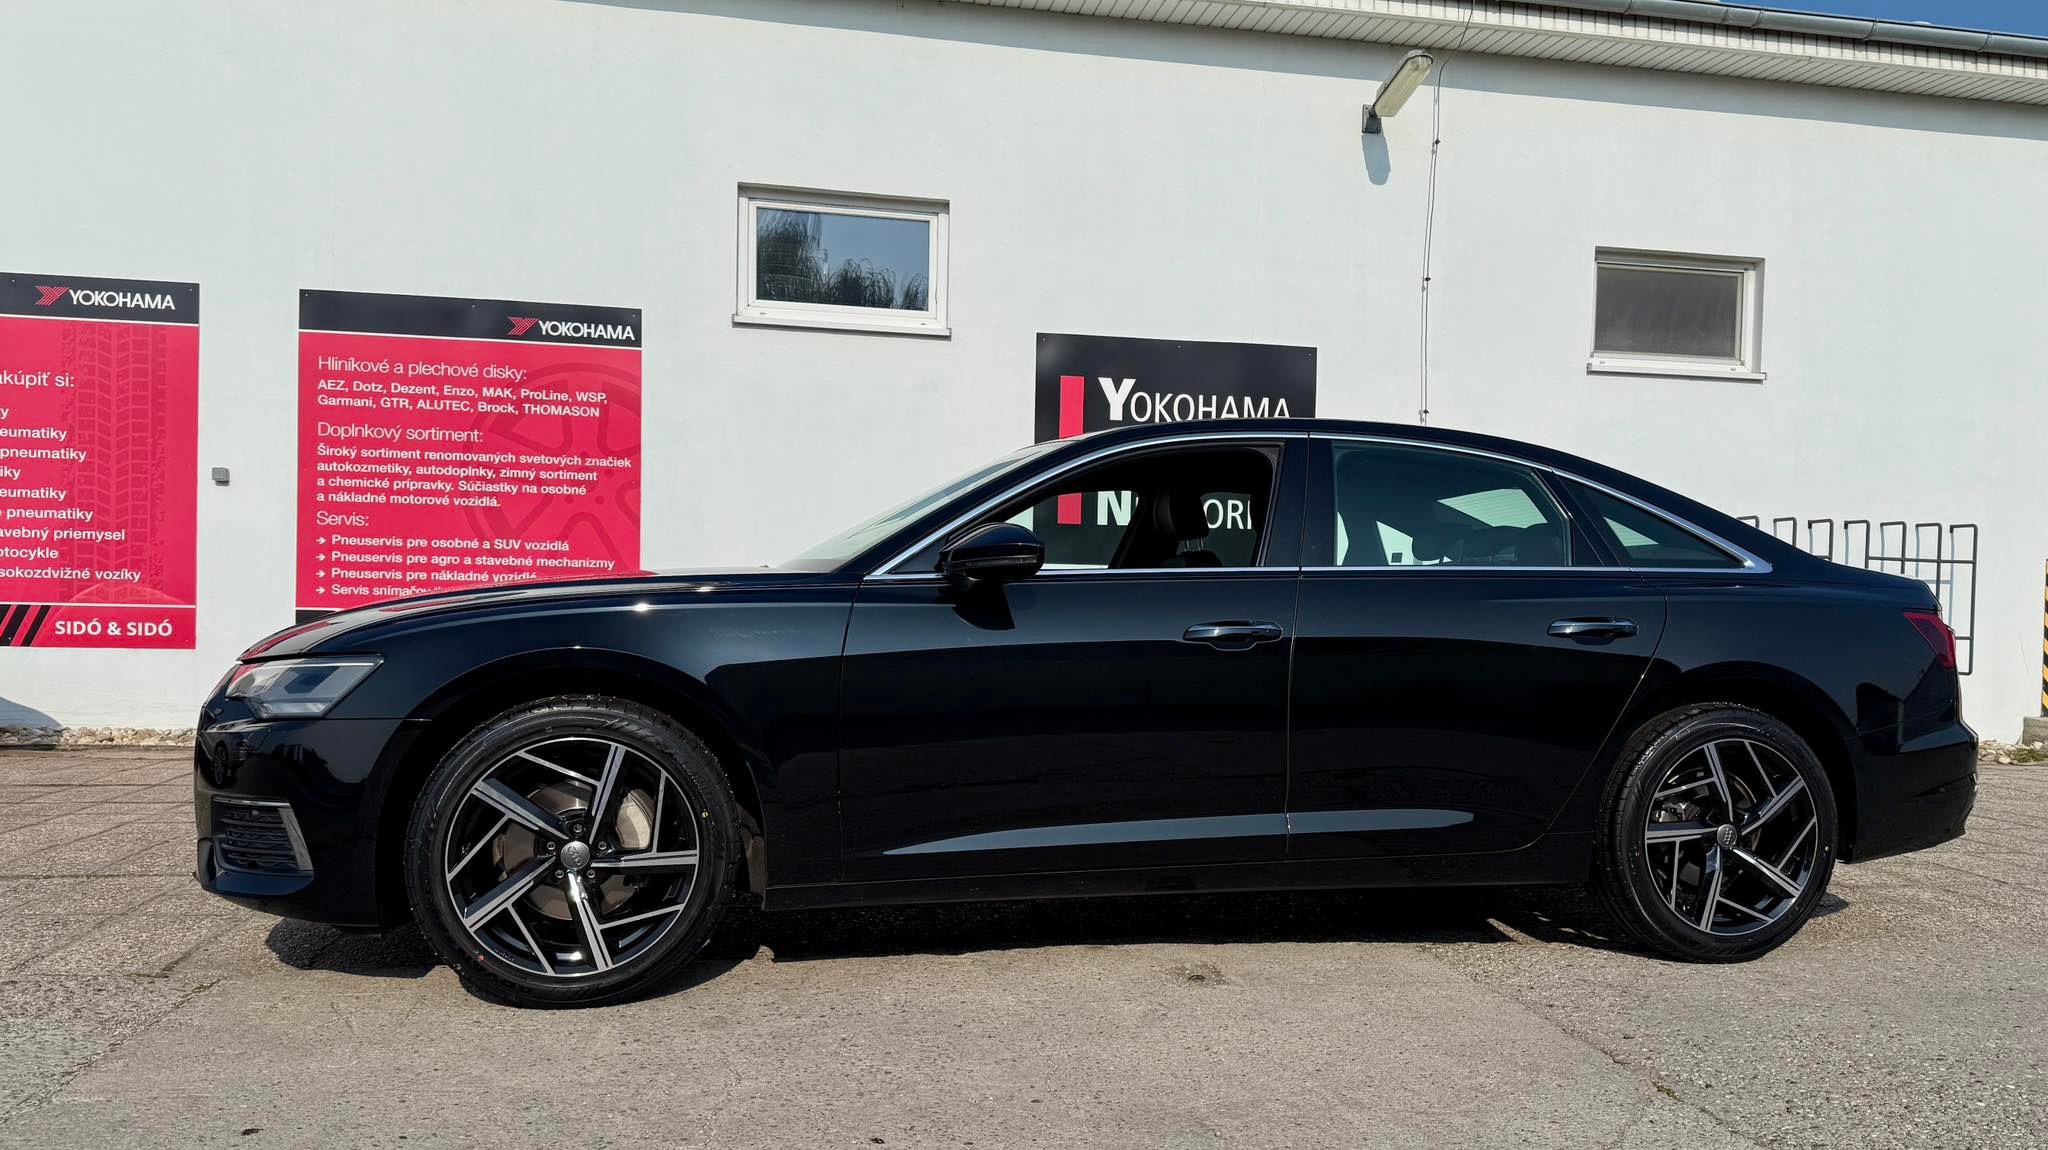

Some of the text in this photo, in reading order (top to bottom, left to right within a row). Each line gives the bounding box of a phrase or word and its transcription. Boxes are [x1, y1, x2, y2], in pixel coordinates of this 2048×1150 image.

[69, 290, 176, 310] YOKOHAMA
[539, 321, 636, 341] YOKOHAMA
[319, 356, 527, 383] Hliníkové a plechové disky:
[0, 370, 75, 389] kúpiť si:
[318, 380, 608, 405] AEZ, Dotz, Dezent, Enzo, MAK, ProLine, WSP,
[1098, 377, 1290, 422] YOKOHAMA
[318, 395, 600, 418] Garmani, GTR, ALUTEC, Brock, THOMASON
[318, 422, 483, 443] Doplnkový sortiment:
[317, 443, 632, 468] Široký sortiment renomovaných svetových značiek
[317, 462, 598, 481] autokozmetiky, autodoplnky, zimný sortiment
[317, 476, 587, 496] a chemické prípravky. Súčiastky na osobné
[317, 492, 501, 507] a nákladné motorové vozidlá.
[7, 508, 94, 523] pneumatiky
[317, 511, 369, 527] Servis:
[54, 528, 126, 543] priemysel
[332, 535, 570, 552] Pneuservis pre osobné a SUV vozidlá
[332, 551, 615, 571] Pneuservis pre agro a stavebné mechanizmy
[95, 569, 142, 583] vozíky
[332, 568, 404, 580] Pneuservis
[407, 572, 428, 582] pre
[431, 570, 490, 582] nákladné
[332, 584, 370, 596] Servis
[56, 618, 173, 637] SIDÓ & SIDÓ
